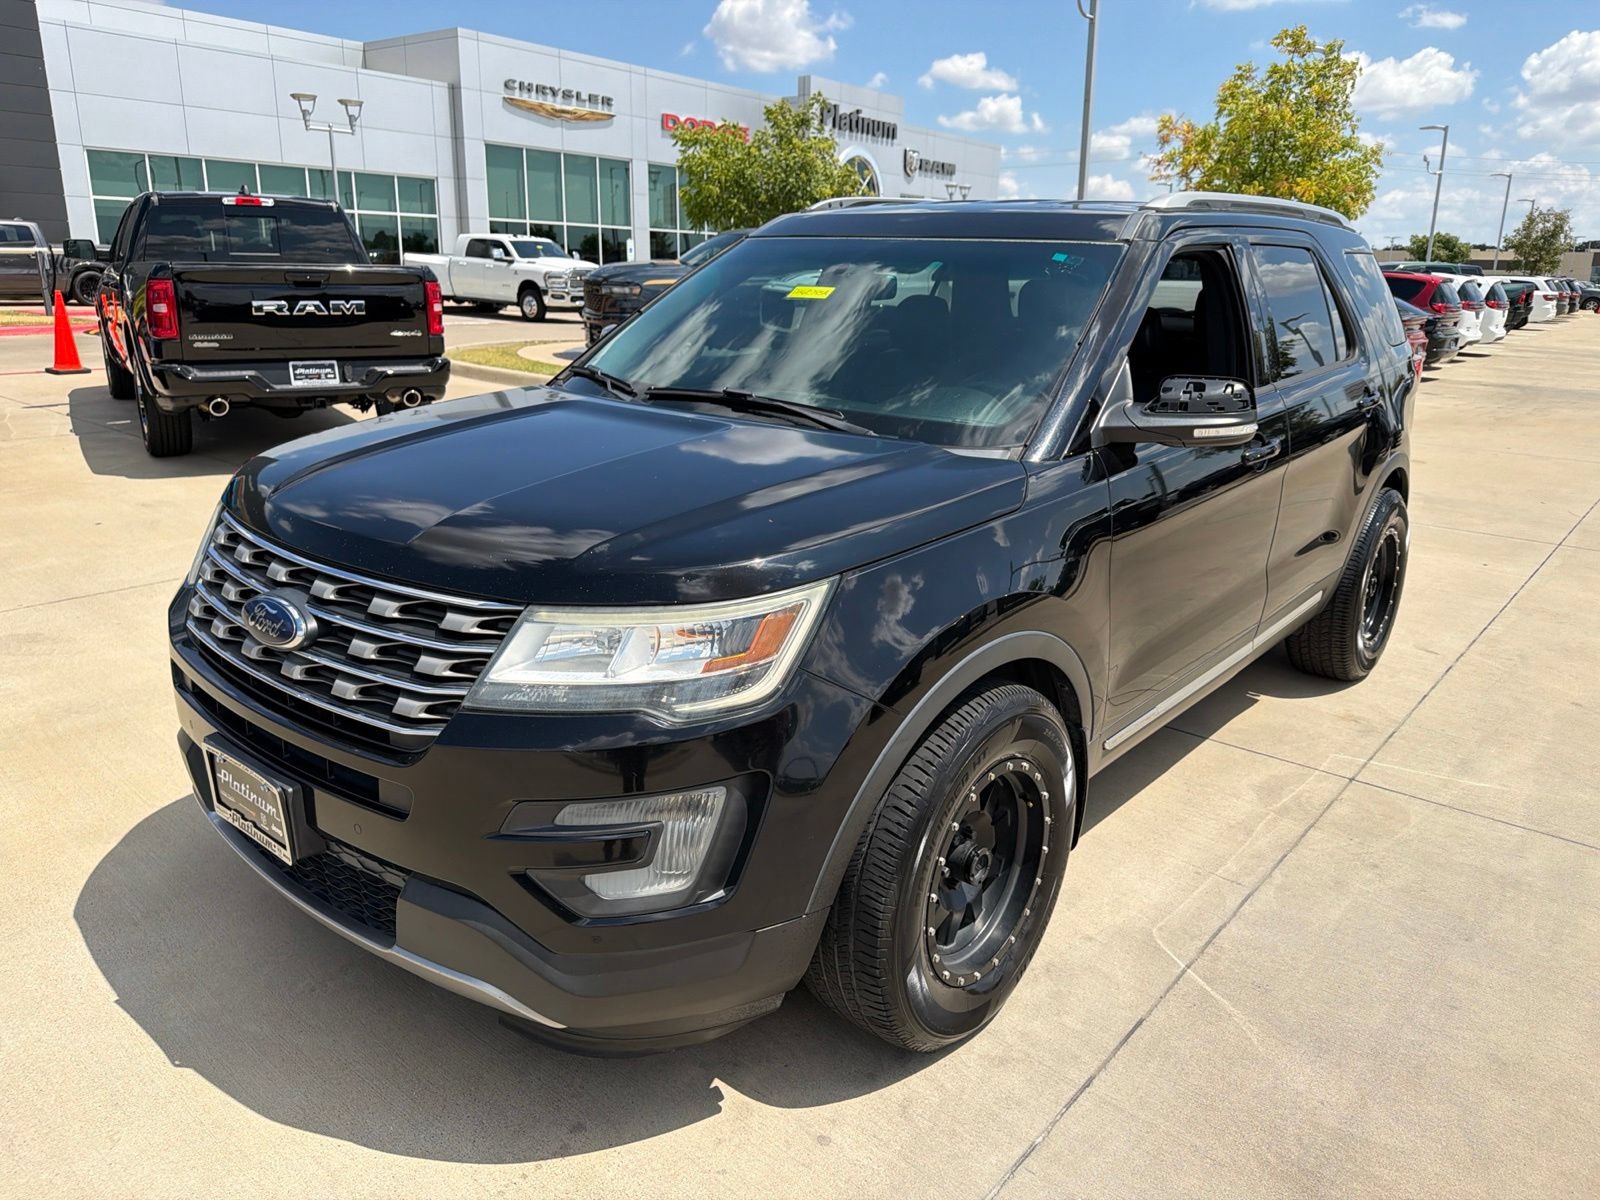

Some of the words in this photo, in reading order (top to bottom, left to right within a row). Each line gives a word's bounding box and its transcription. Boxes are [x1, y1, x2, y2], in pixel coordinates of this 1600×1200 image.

[503, 79, 615, 107] CHRYSLER
[661, 113, 749, 144] DOE
[820, 102, 897, 140] Platinum
[919, 158, 956, 176] RAM
[252, 300, 366, 315] RAM
[249, 603, 284, 637] Ford
[217, 769, 281, 822] Platinum
[229, 809, 277, 850] Platinum
